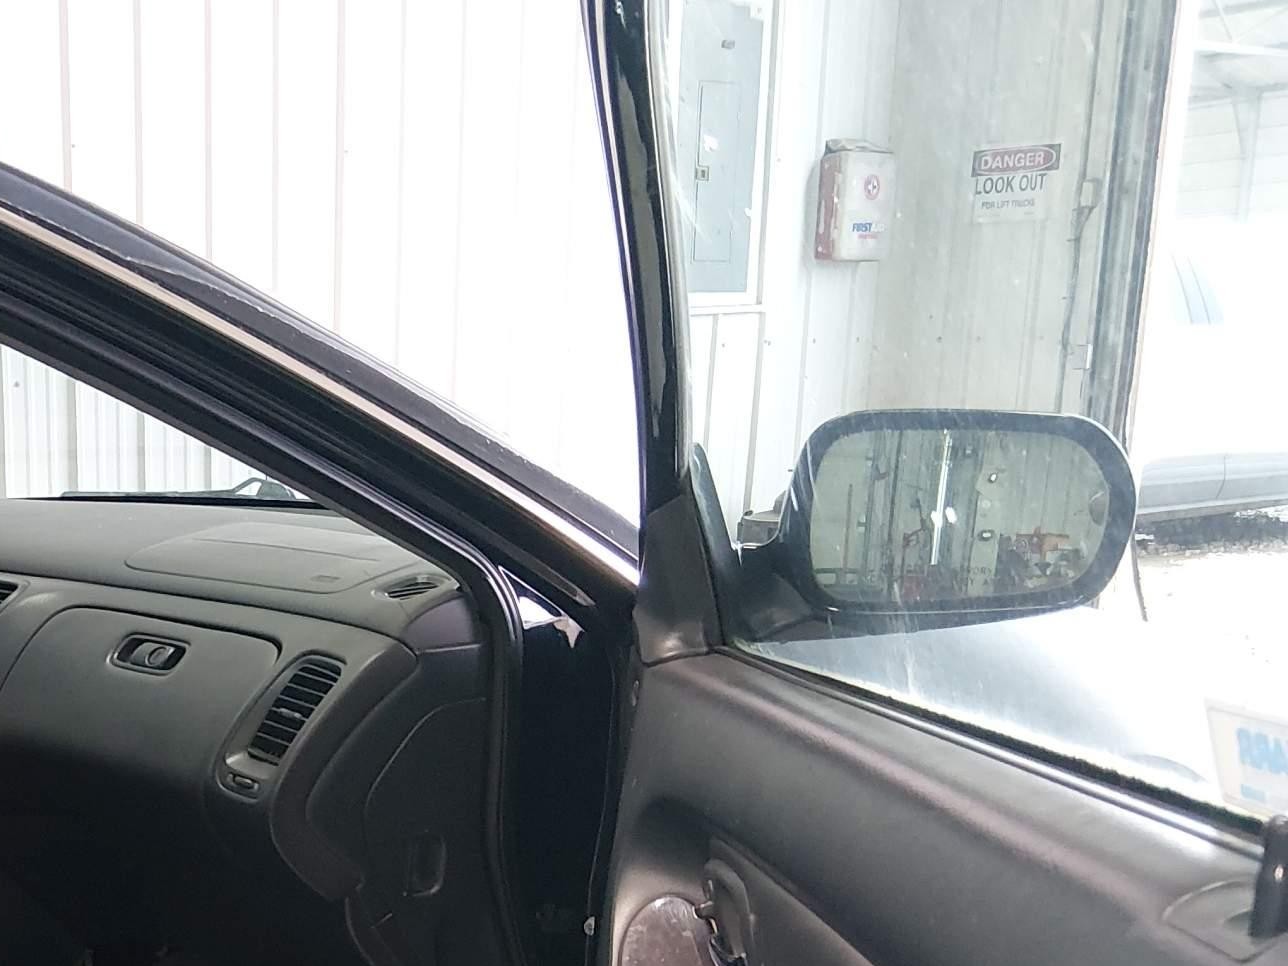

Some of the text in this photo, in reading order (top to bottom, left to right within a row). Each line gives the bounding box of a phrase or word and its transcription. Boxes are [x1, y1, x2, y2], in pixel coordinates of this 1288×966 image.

[980, 151, 1045, 170] DANGER
[975, 173, 1048, 195] LOOK OUT
[981, 200, 995, 210] FOR
